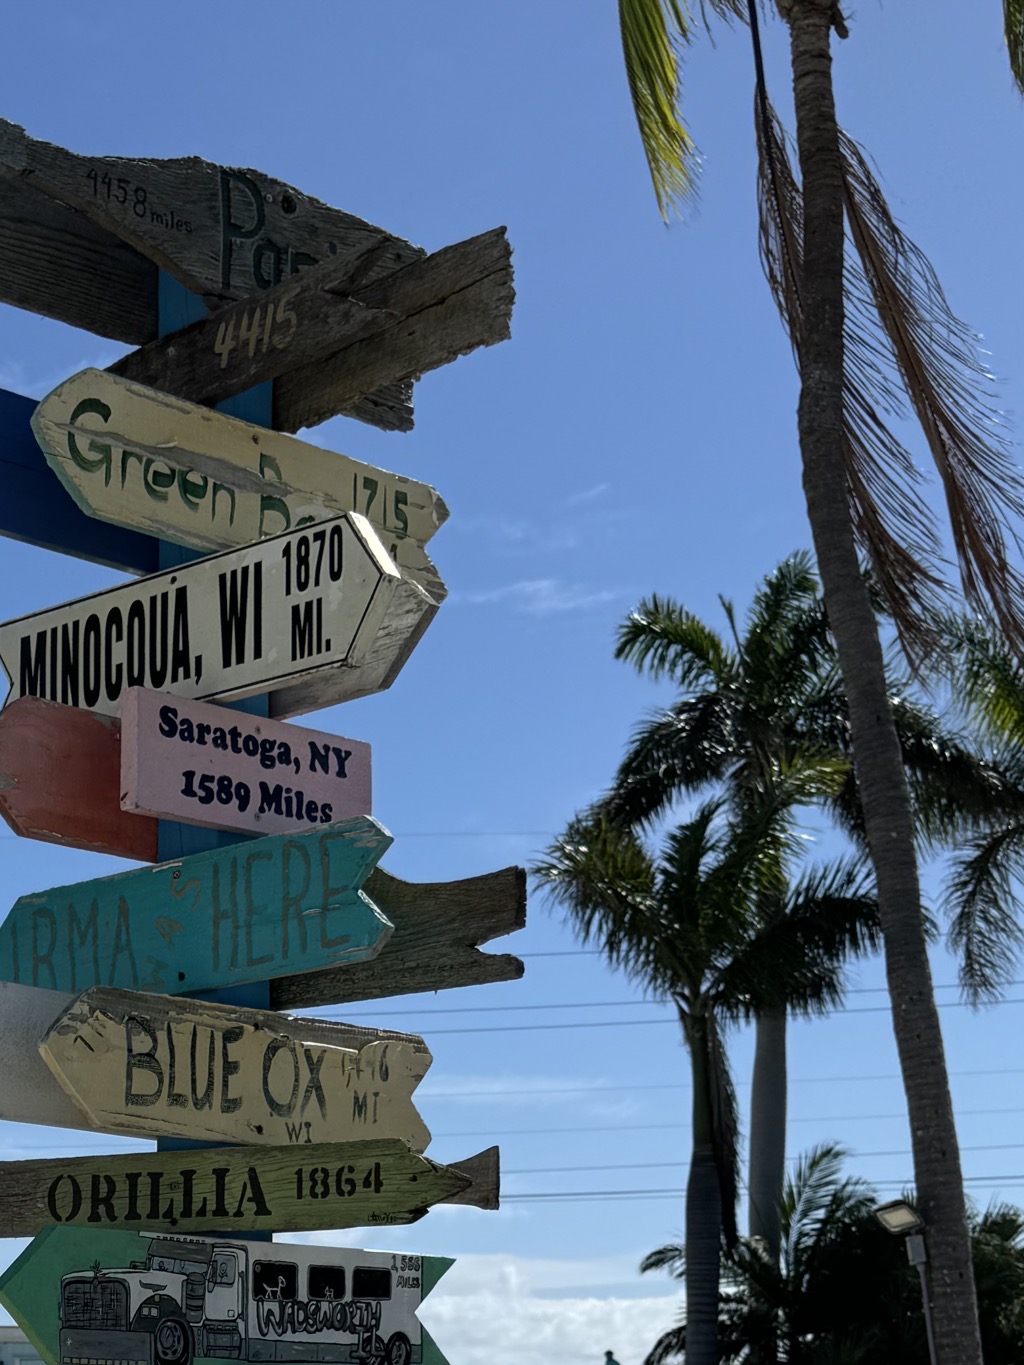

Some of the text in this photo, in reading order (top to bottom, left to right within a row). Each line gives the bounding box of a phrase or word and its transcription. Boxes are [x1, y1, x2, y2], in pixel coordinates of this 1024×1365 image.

[86, 168, 193, 233] 4458 miles
[214, 287, 301, 369] 4415
[67, 397, 236, 528] Green
[282, 525, 343, 597] 1870
[20, 561, 263, 708] MINOCQUA, WI
[291, 597, 331, 662] MI.
[158, 705, 352, 778] Saratoga, NY
[181, 770, 333, 824] 1589 Miles
[9, 896, 140, 994] IRMA
[212, 832, 354, 971] HERE
[126, 1016, 245, 1114] BLUE
[262, 1034, 328, 1120] OX
[285, 1121, 313, 1144] WI
[47, 1163, 384, 1223] ORILLIA 1864
[257, 1299, 381, 1336] WADSWORTH
